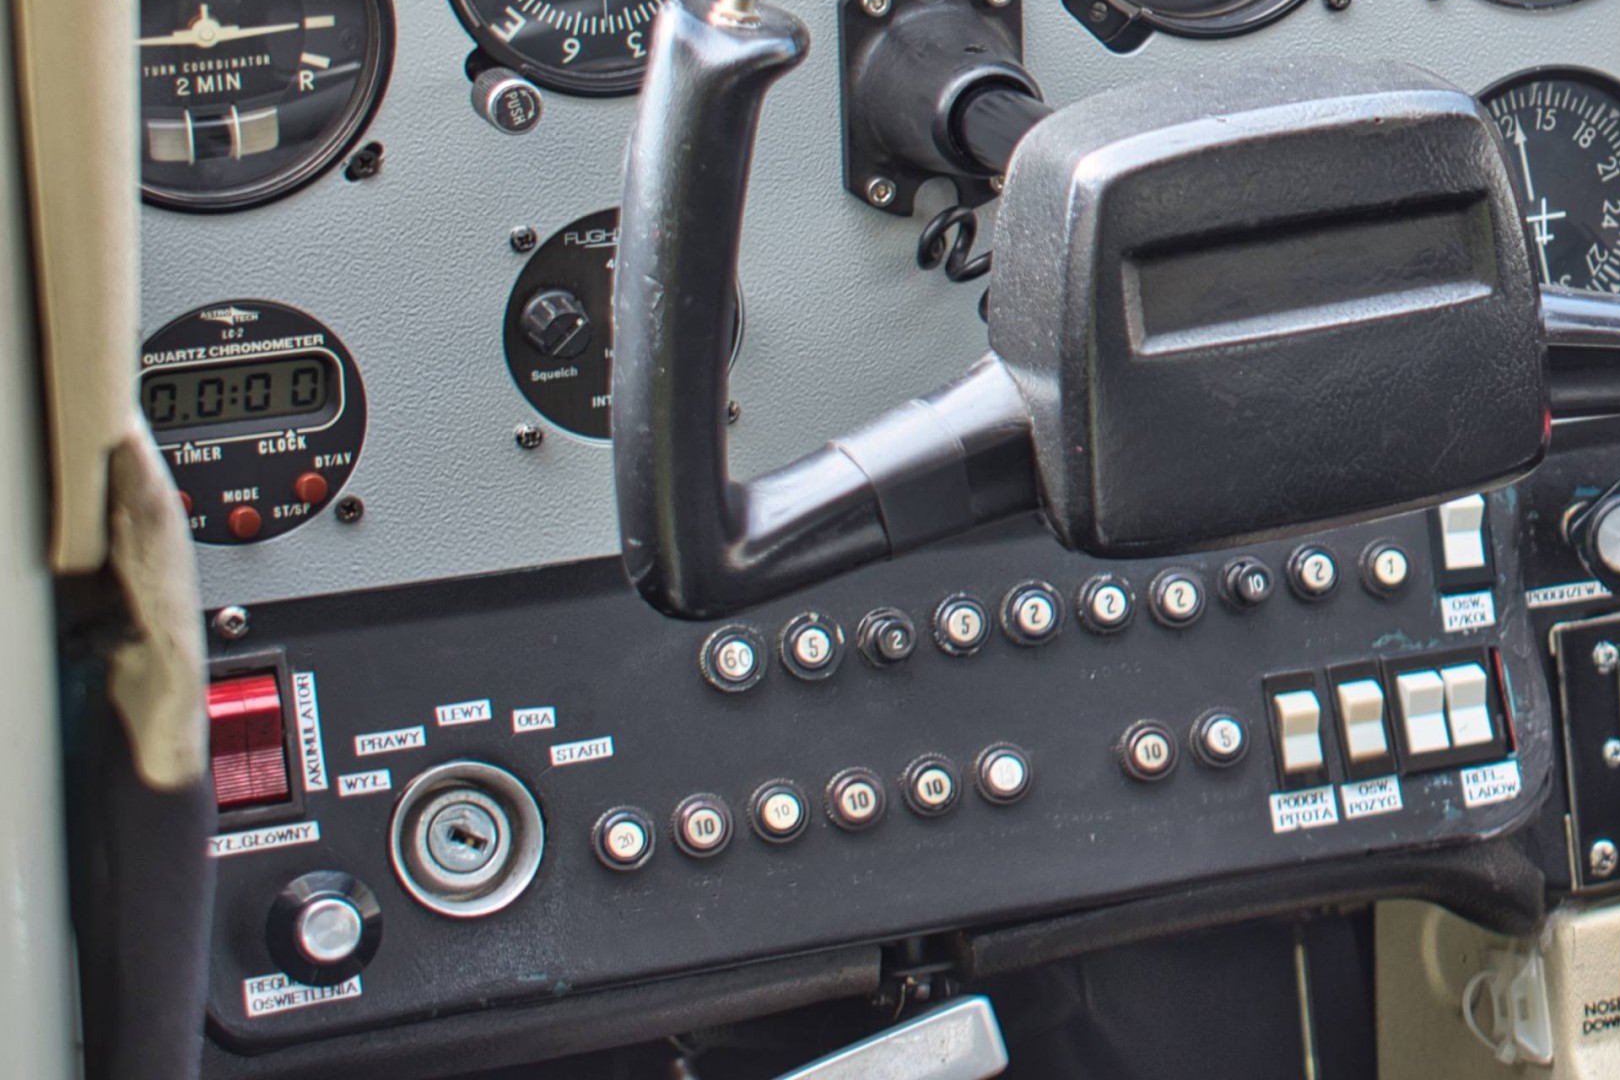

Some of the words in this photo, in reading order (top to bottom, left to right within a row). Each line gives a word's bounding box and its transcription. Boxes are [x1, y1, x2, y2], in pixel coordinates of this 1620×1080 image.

[490, 5, 527, 43] E
[143, 65, 176, 78] TURN
[183, 54, 272, 74] COORDINATOR
[176, 79, 191, 97] 2
[197, 73, 243, 94] MIN
[300, 70, 316, 92] R
[503, 91, 527, 126] PUSH
[1535, 107, 1557, 132] 15
[1572, 121, 1597, 149] 18
[1596, 155, 1620, 182] 21
[1585, 242, 1608, 276] 27
[142, 346, 206, 366] QUARTZ
[208, 333, 325, 358] CHRONOMETER
[531, 366, 578, 382] Squelch
[173, 445, 223, 466] TIMER
[257, 436, 308, 456] CLOCK
[313, 451, 353, 469] DT/AV
[222, 487, 260, 504] MODE
[272, 502, 312, 519] ST/SP
[1312, 560, 1326, 582] 2
[1247, 574, 1264, 592] 10
[1104, 592, 1117, 615] 2
[1173, 586, 1189, 608] 2
[960, 614, 972, 635] 5
[1029, 603, 1043, 626] 2
[807, 636, 820, 660] 5
[892, 634, 903, 649] 2
[723, 646, 751, 670] 60
[440, 704, 488, 724] LEWY
[517, 711, 553, 729] OBA
[295, 672, 325, 788] AKUMULATOR
[1219, 727, 1232, 746] 5
[360, 732, 422, 753] PRAWY
[555, 741, 612, 763] START
[1142, 742, 1161, 762] 10
[924, 777, 943, 797] 10
[773, 803, 791, 818] 10
[847, 791, 869, 813] 10
[694, 815, 715, 837] 10
[1279, 809, 1333, 827] PITOTA
[617, 832, 637, 850] 20
